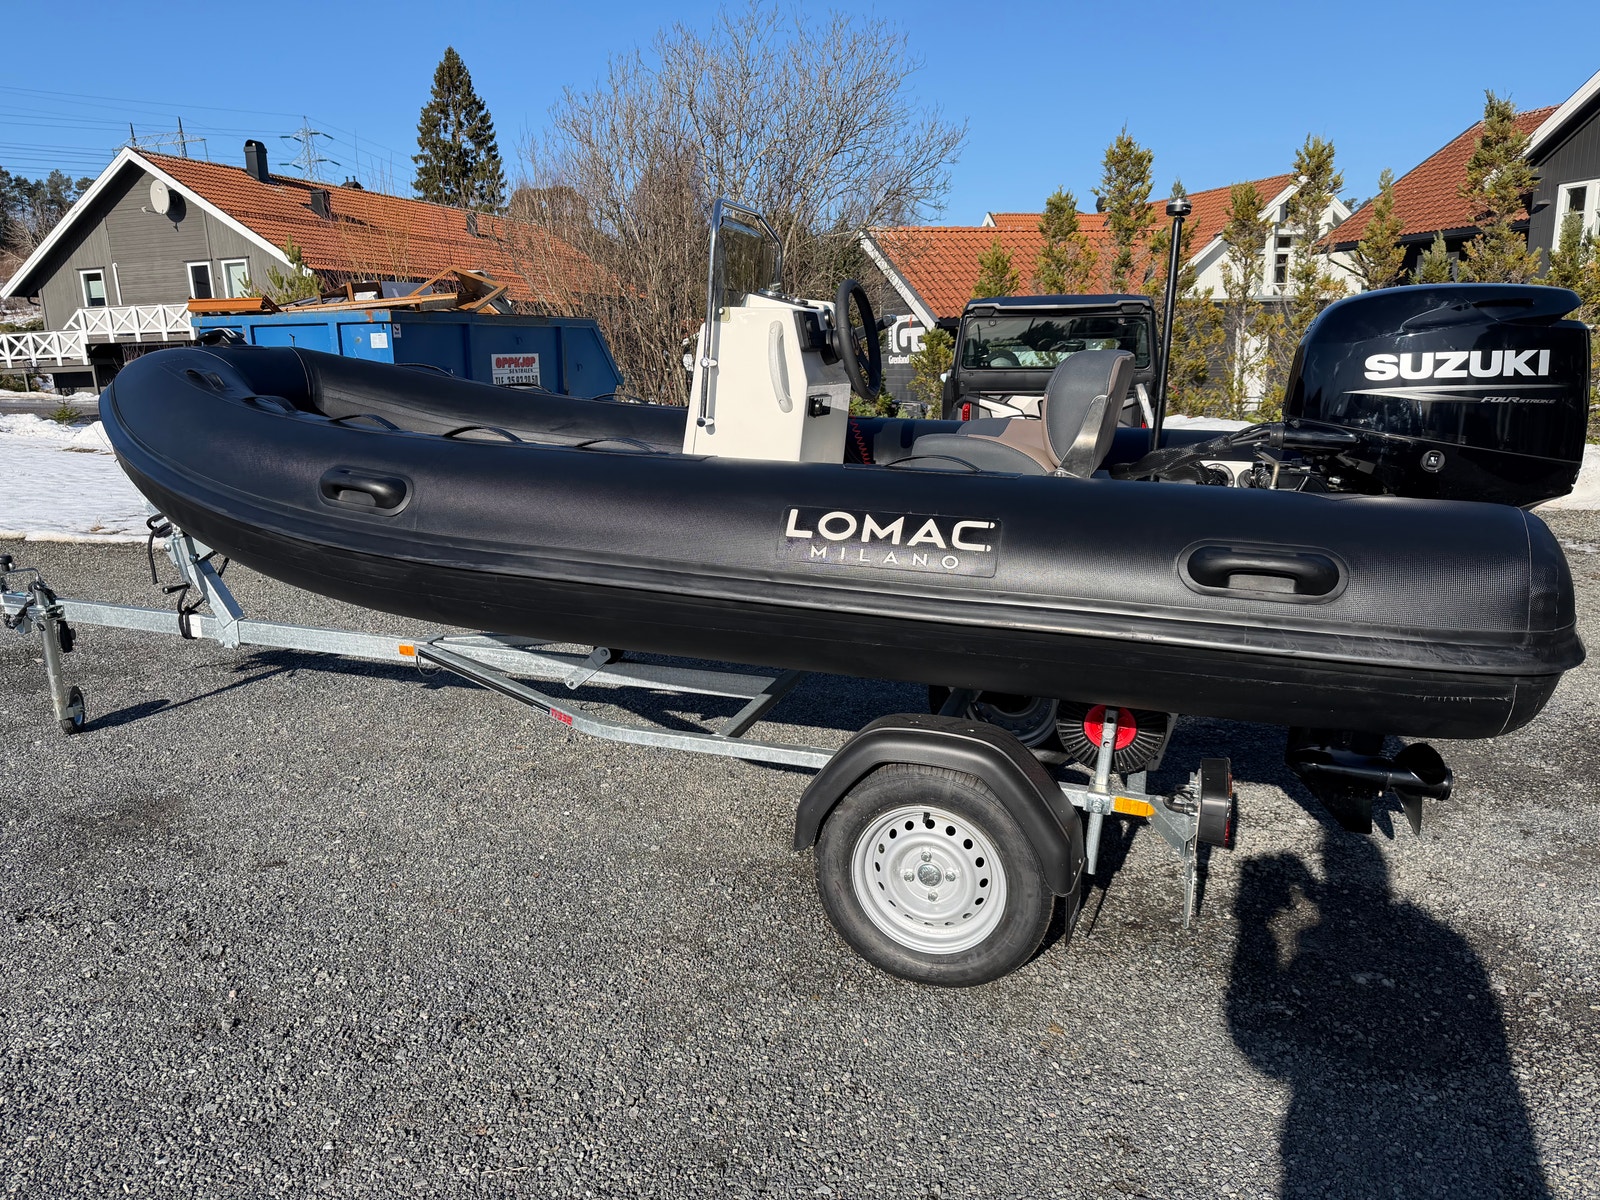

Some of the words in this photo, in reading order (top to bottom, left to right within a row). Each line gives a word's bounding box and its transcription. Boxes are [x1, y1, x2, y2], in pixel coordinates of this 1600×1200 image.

[1364, 349, 1550, 381] SUZUKI
[785, 508, 996, 552] LOMAC
[810, 545, 960, 570] MILANO
